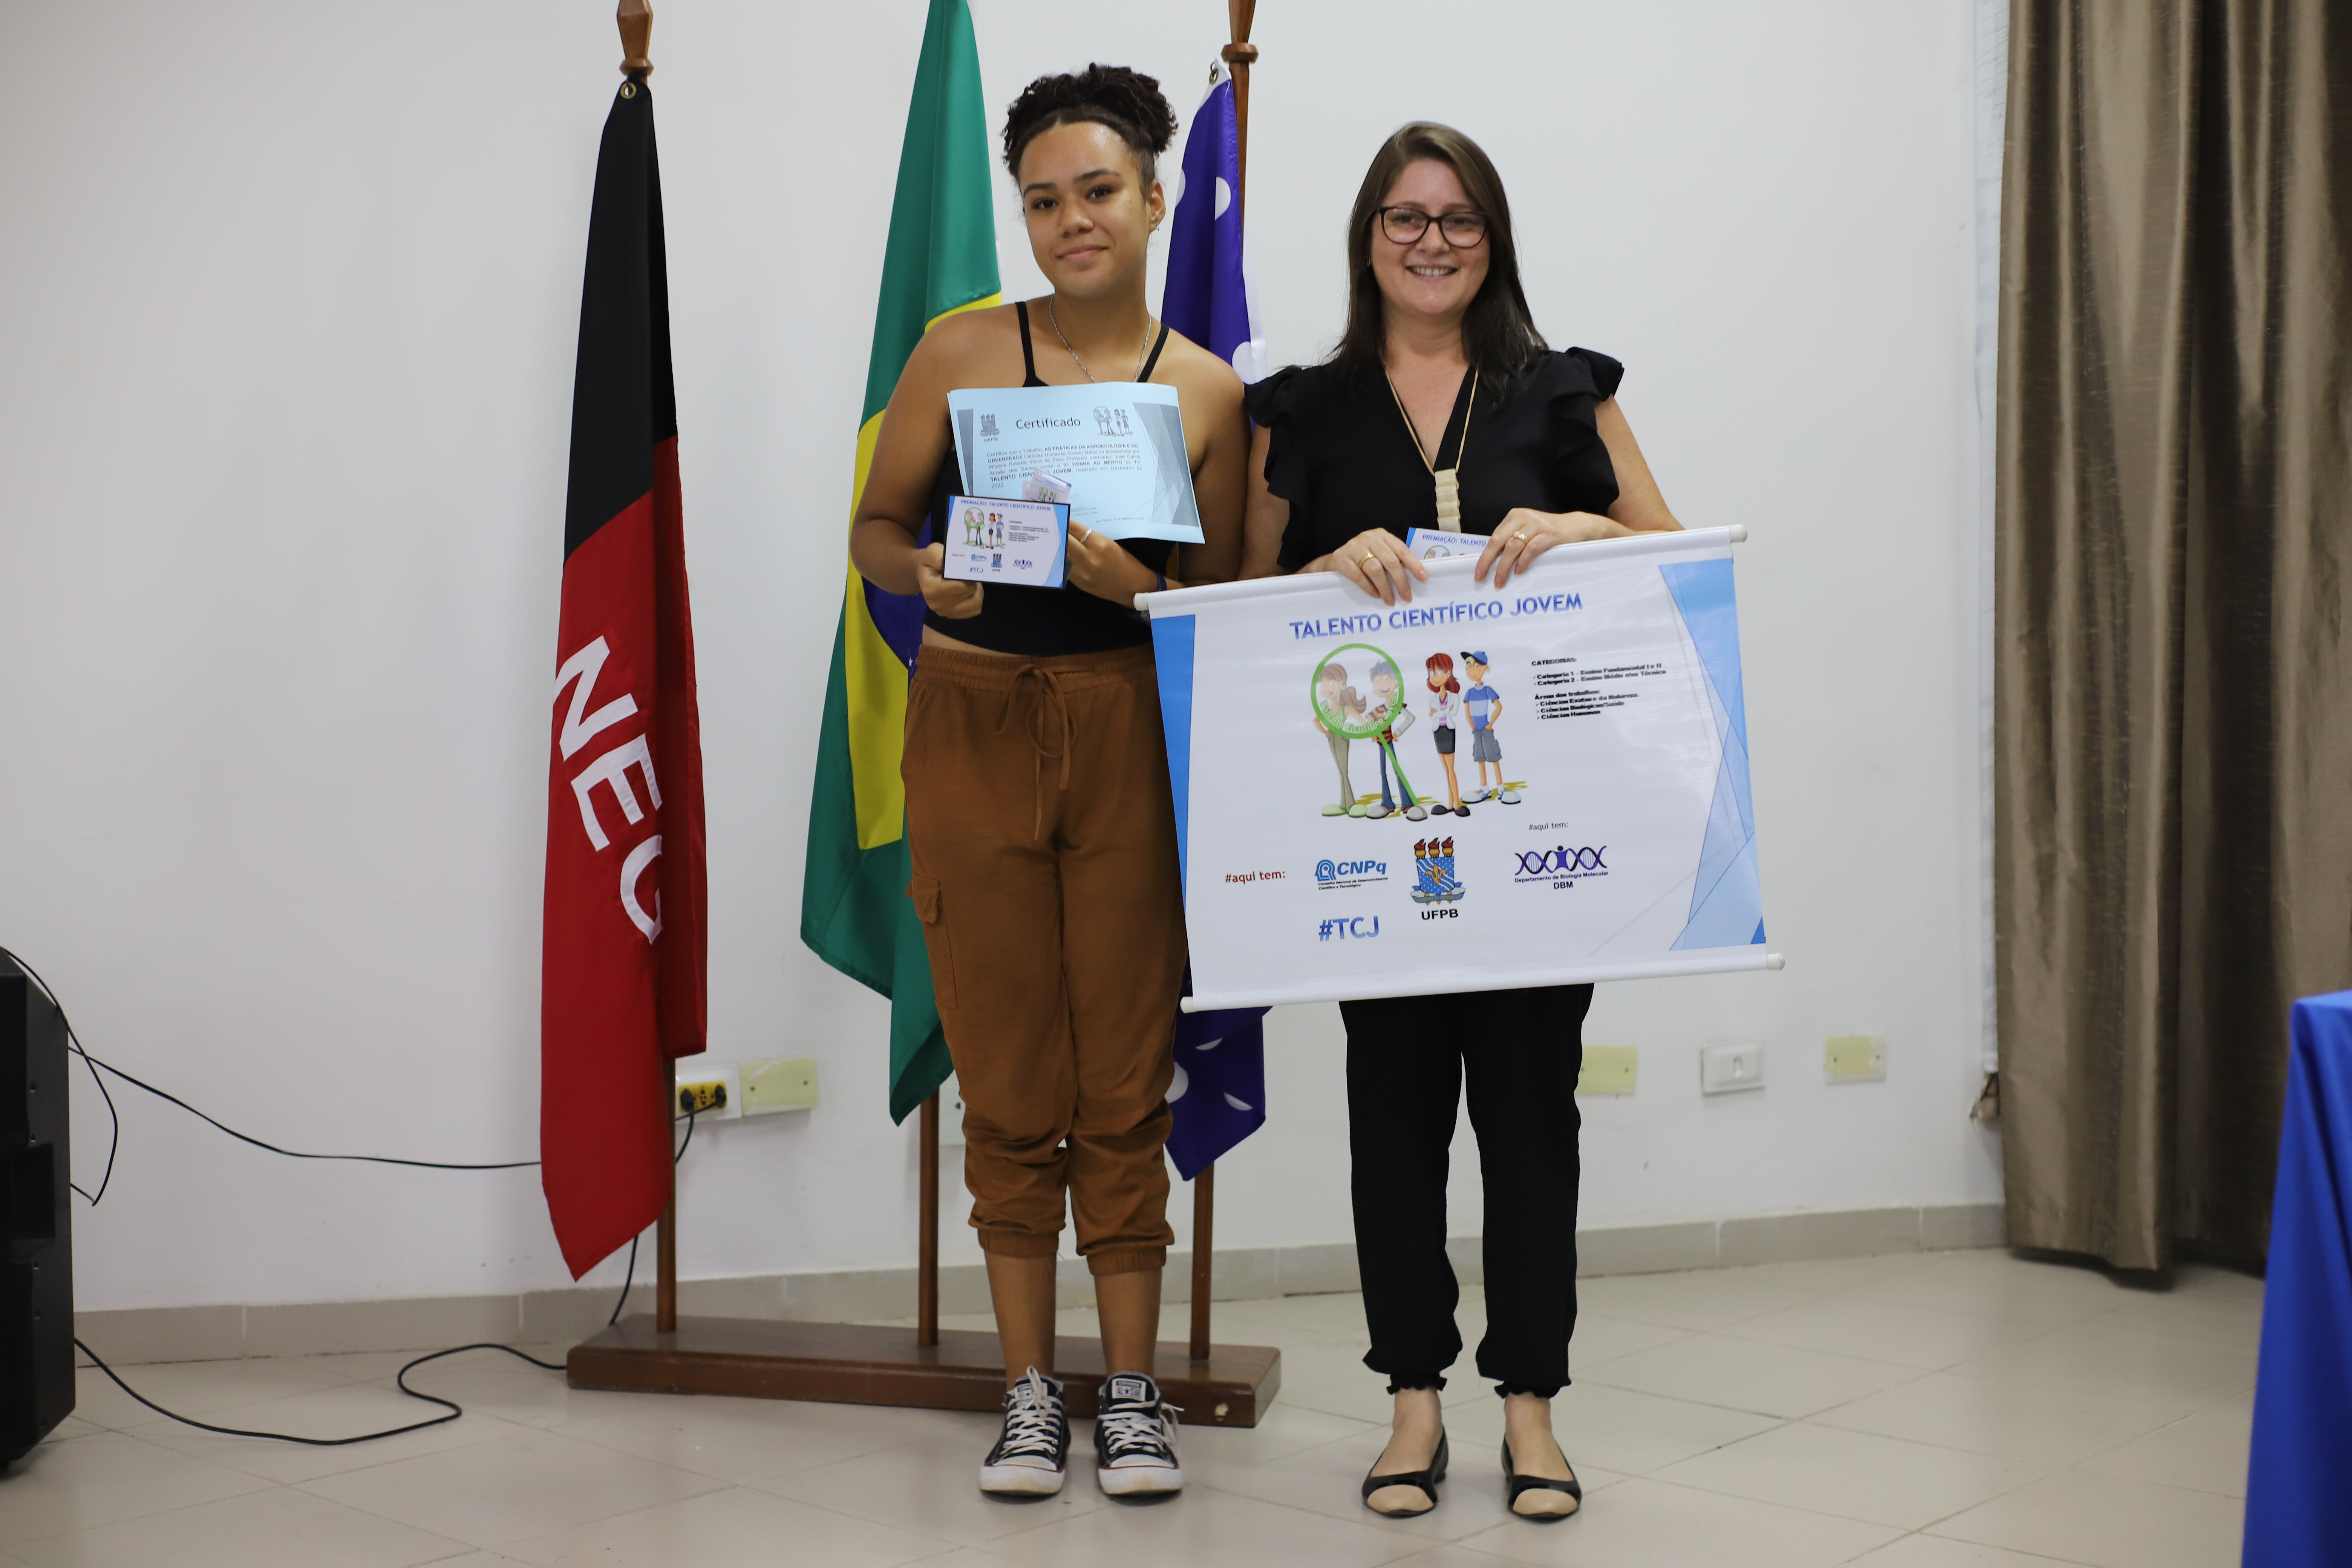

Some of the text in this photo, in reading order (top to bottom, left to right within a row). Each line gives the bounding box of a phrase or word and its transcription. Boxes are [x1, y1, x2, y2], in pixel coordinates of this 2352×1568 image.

[1016, 416, 1081, 429] Certificado
[988, 455, 1023, 463] GREENPEACE
[1422, 534, 1458, 543] PREMIAÇÃO:
[1289, 593, 1583, 640] TALENTO CIENTÍFICO JOVEM
[1603, 665, 1645, 673] Fundamental
[1320, 691, 1399, 732] Talento Científico Jovem
[1529, 822, 1548, 831] #aqui
[1337, 861, 1387, 875] CNPq
[1225, 871, 1286, 884] #aqui tem:
[1421, 909, 1458, 920] UFPB
[1318, 916, 1379, 941] #TCJ
